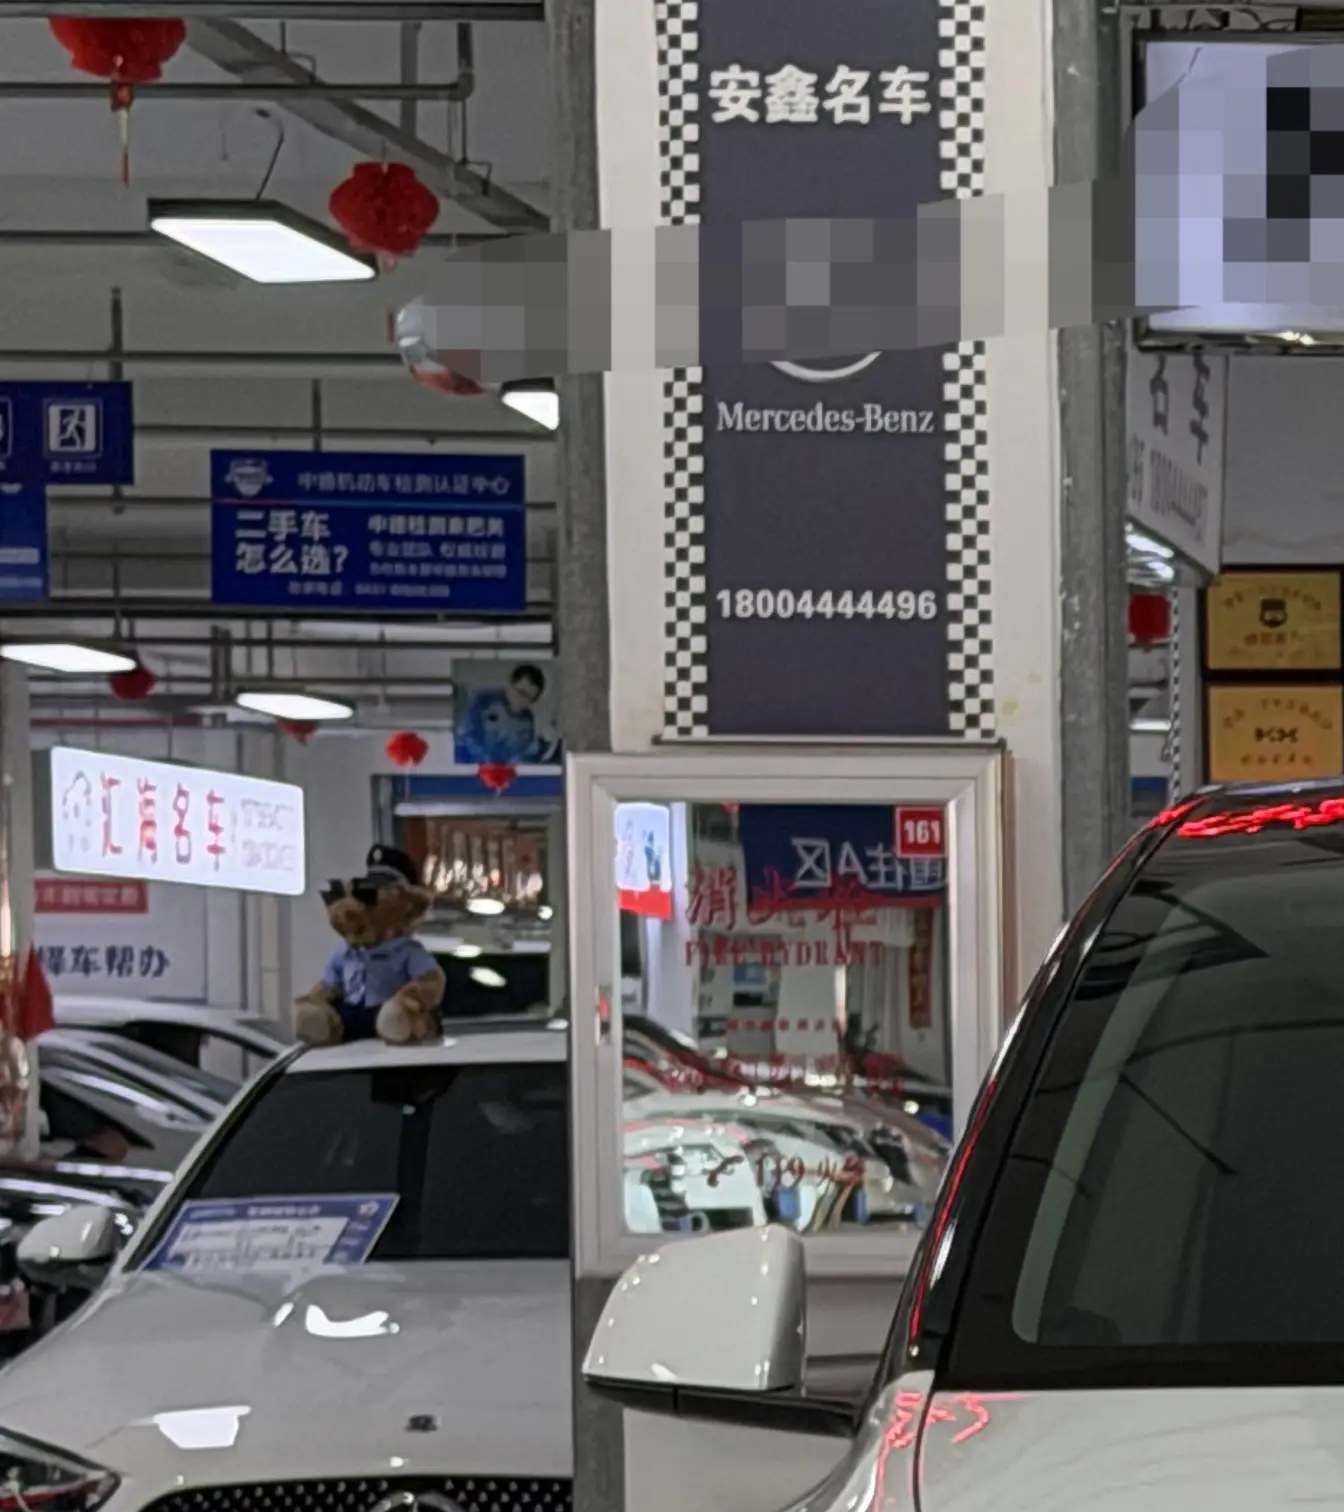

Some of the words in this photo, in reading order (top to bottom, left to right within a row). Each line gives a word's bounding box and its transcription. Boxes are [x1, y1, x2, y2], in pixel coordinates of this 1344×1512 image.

[708, 64, 933, 124] 安鑫名车
[716, 401, 935, 434] Mercedes-Benz
[235, 509, 331, 541] 二手车
[716, 588, 938, 620] 18004444496
[904, 819, 942, 845] 161
[760, 940, 885, 967] HYDRANT
